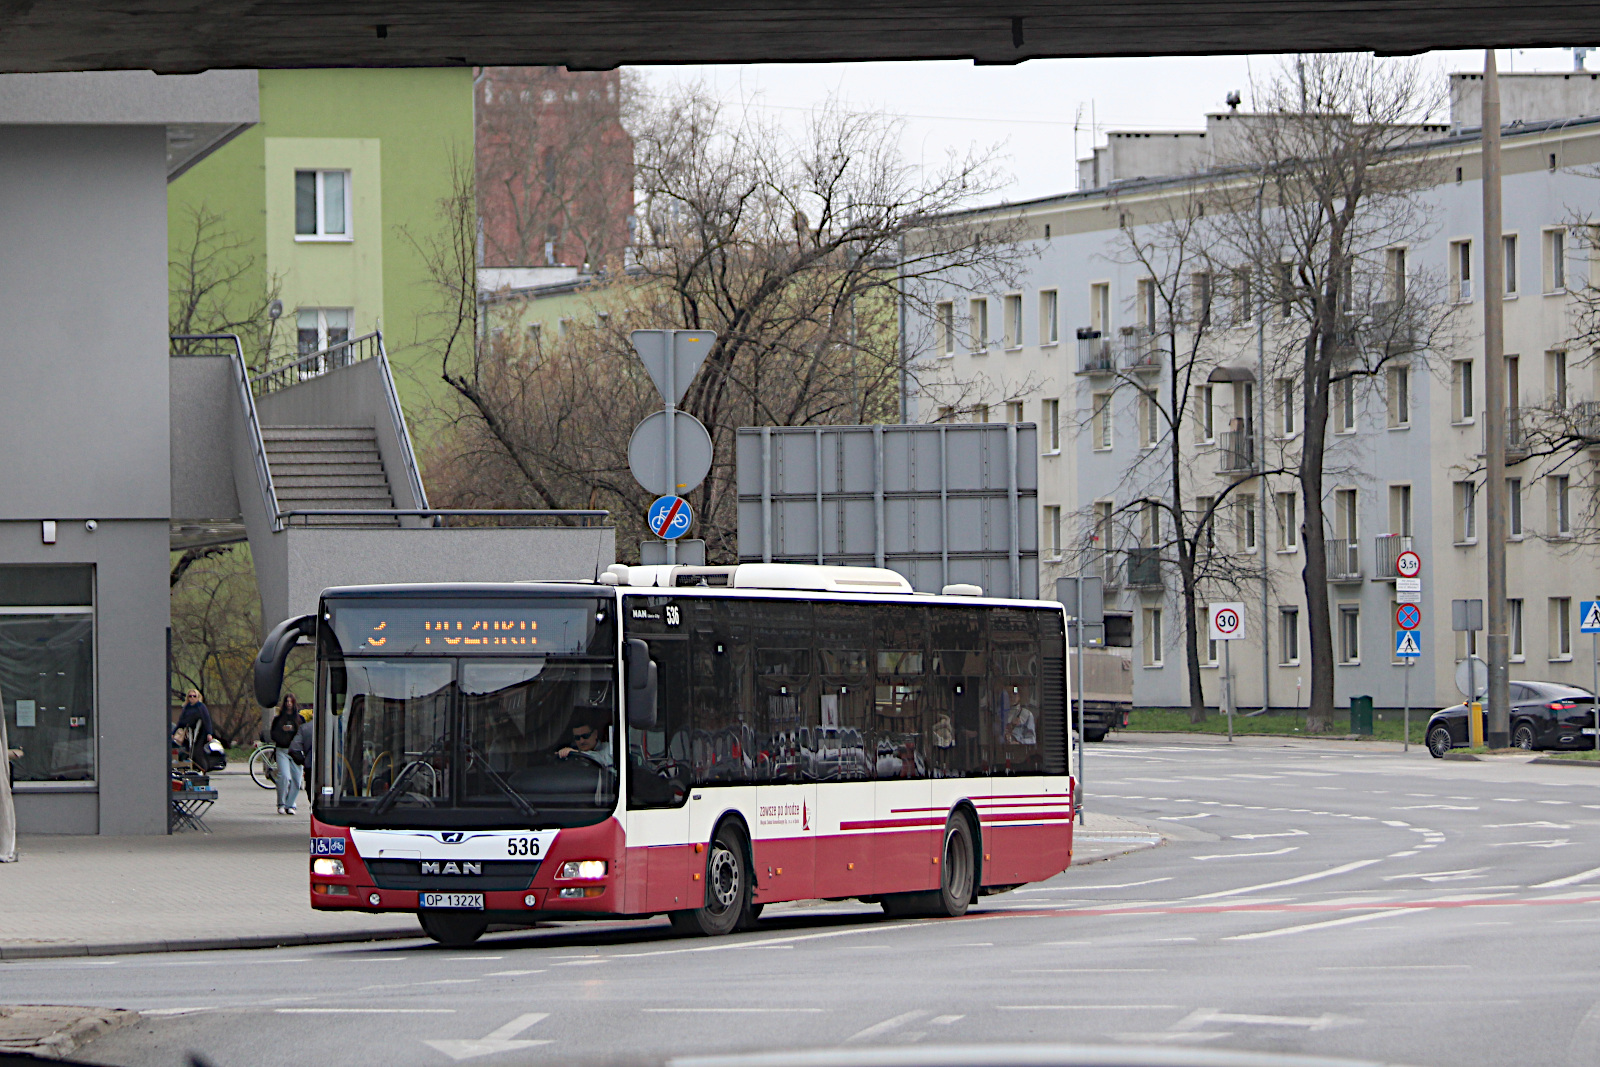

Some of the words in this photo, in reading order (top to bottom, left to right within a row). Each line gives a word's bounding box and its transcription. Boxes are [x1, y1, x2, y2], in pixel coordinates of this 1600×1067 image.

[1400, 558, 1417, 569] 3,5t
[666, 605, 680, 625] 536
[1219, 615, 1235, 627] 30
[507, 837, 540, 856] 536
[421, 861, 482, 875] MAN
[426, 894, 443, 907] OP
[447, 895, 481, 907] 1322K
